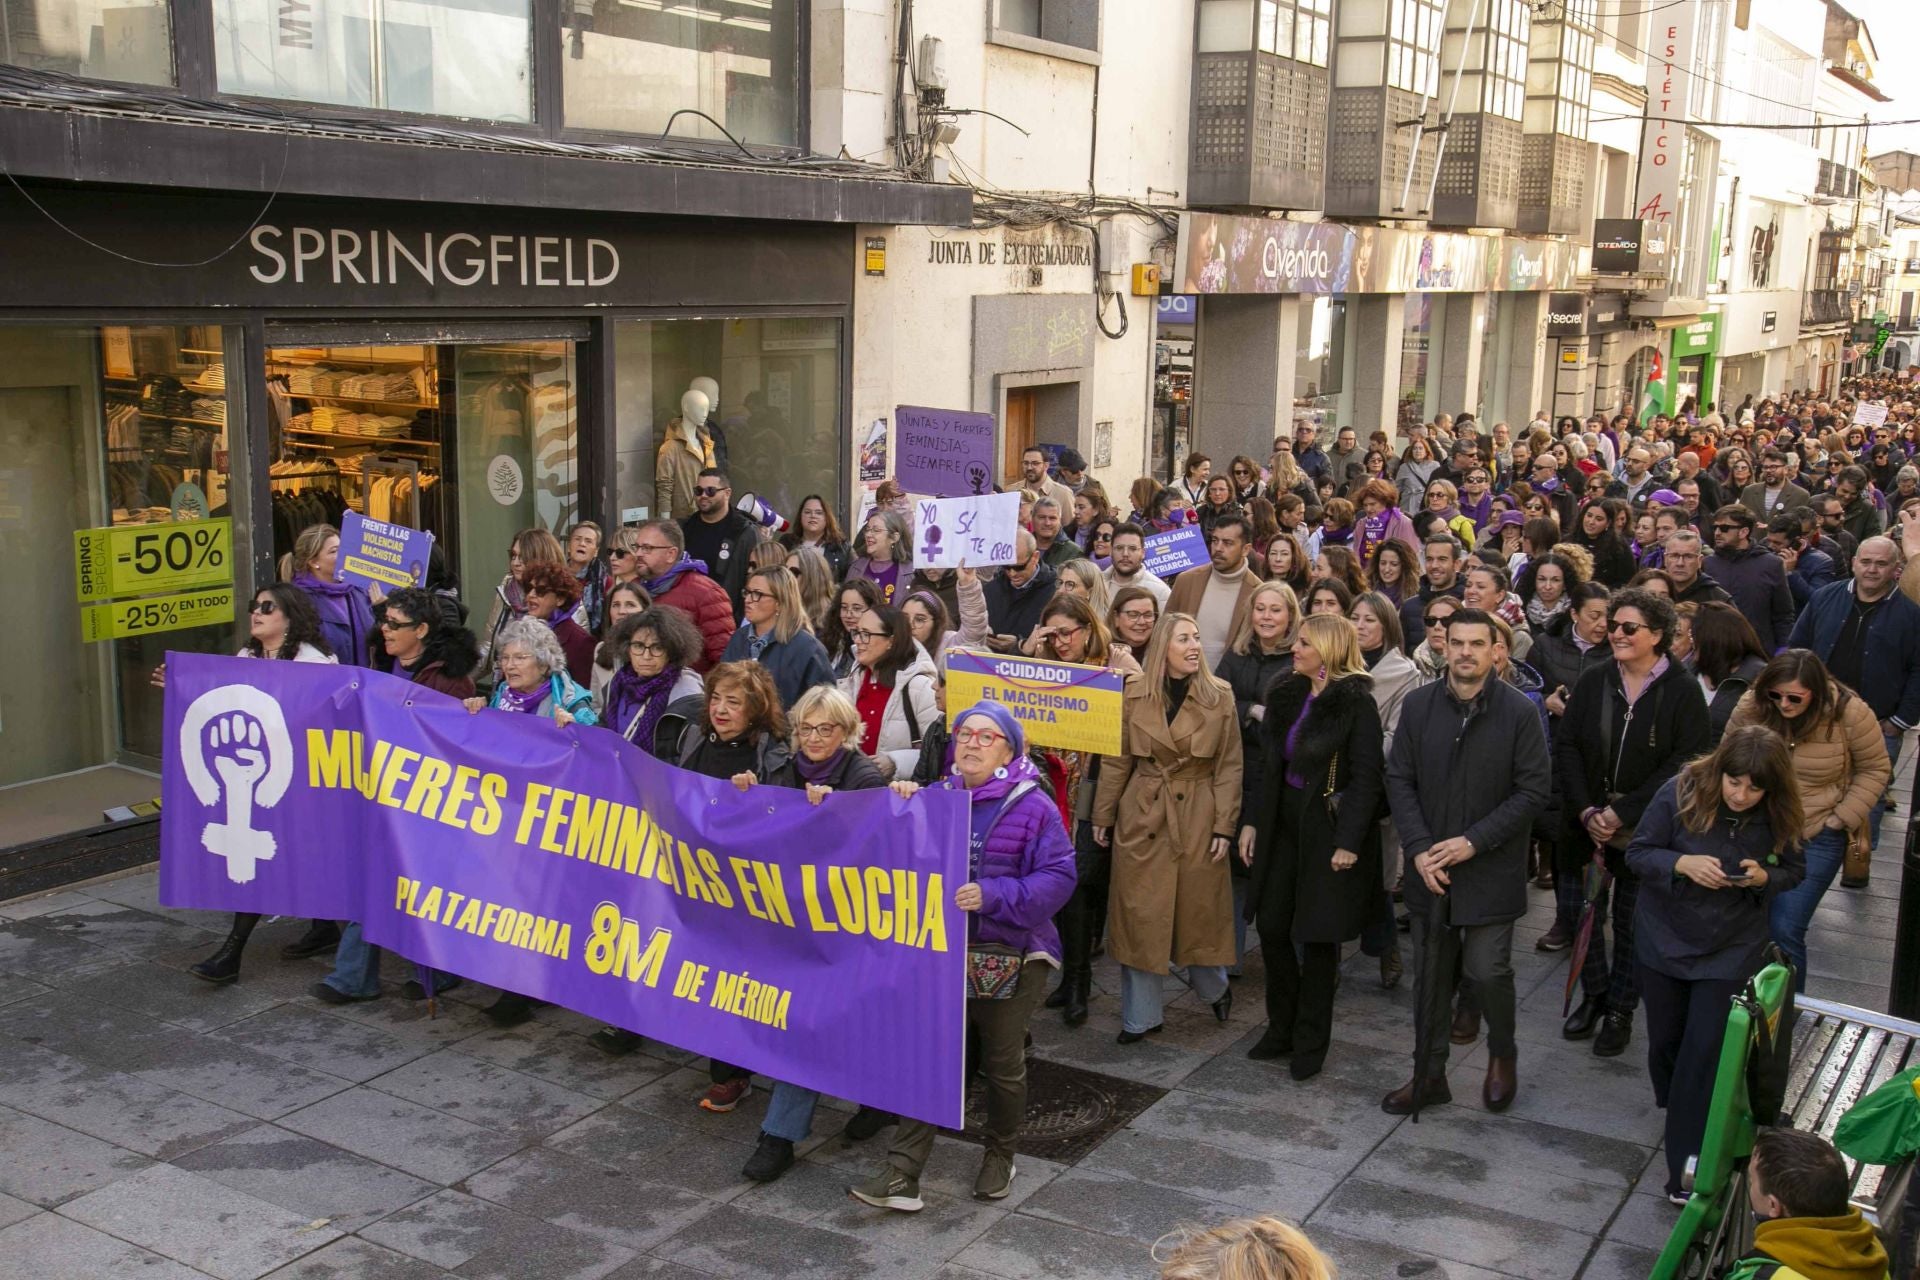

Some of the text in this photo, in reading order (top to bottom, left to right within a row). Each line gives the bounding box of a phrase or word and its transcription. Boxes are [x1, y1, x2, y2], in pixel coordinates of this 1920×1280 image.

[1654, 27, 1676, 166] ESTÉTICO
[249, 224, 620, 287] SPRINGFIELD
[928, 241, 1091, 266] JUNTA DE EXTREMADURA
[1262, 236, 1328, 279] Avenida
[901, 412, 992, 437] JUNTAS Y FUERTES
[905, 432, 970, 455] FEMINISTAS
[905, 454, 961, 474] SIEMPRE
[920, 502, 937, 525] YO
[361, 518, 410, 541] FRENTE A LAS
[1157, 530, 1196, 546] SALARIAL
[118, 528, 223, 574] -50%
[361, 544, 402, 565] MACHISTAS
[363, 532, 404, 553] VIOLENCIAS
[970, 537, 1013, 561] TE CREO
[79, 536, 93, 595] SPRING
[94, 533, 107, 595] SPECIAL
[1145, 550, 1187, 567] VIOLENCIA
[1149, 558, 1194, 575] ATRIARCAL
[118, 601, 178, 630] -25%
[179, 600, 194, 611] EN
[995, 662, 1072, 683] ¡CUIDADO!
[982, 686, 1088, 712] EL MACHISMO
[1013, 705, 1057, 723] MATA
[306, 729, 948, 952] MUJERES FEMINISTAS EN LUCHA
[396, 876, 792, 1031] PLATAFORMA 8M DE MÉRIDA
